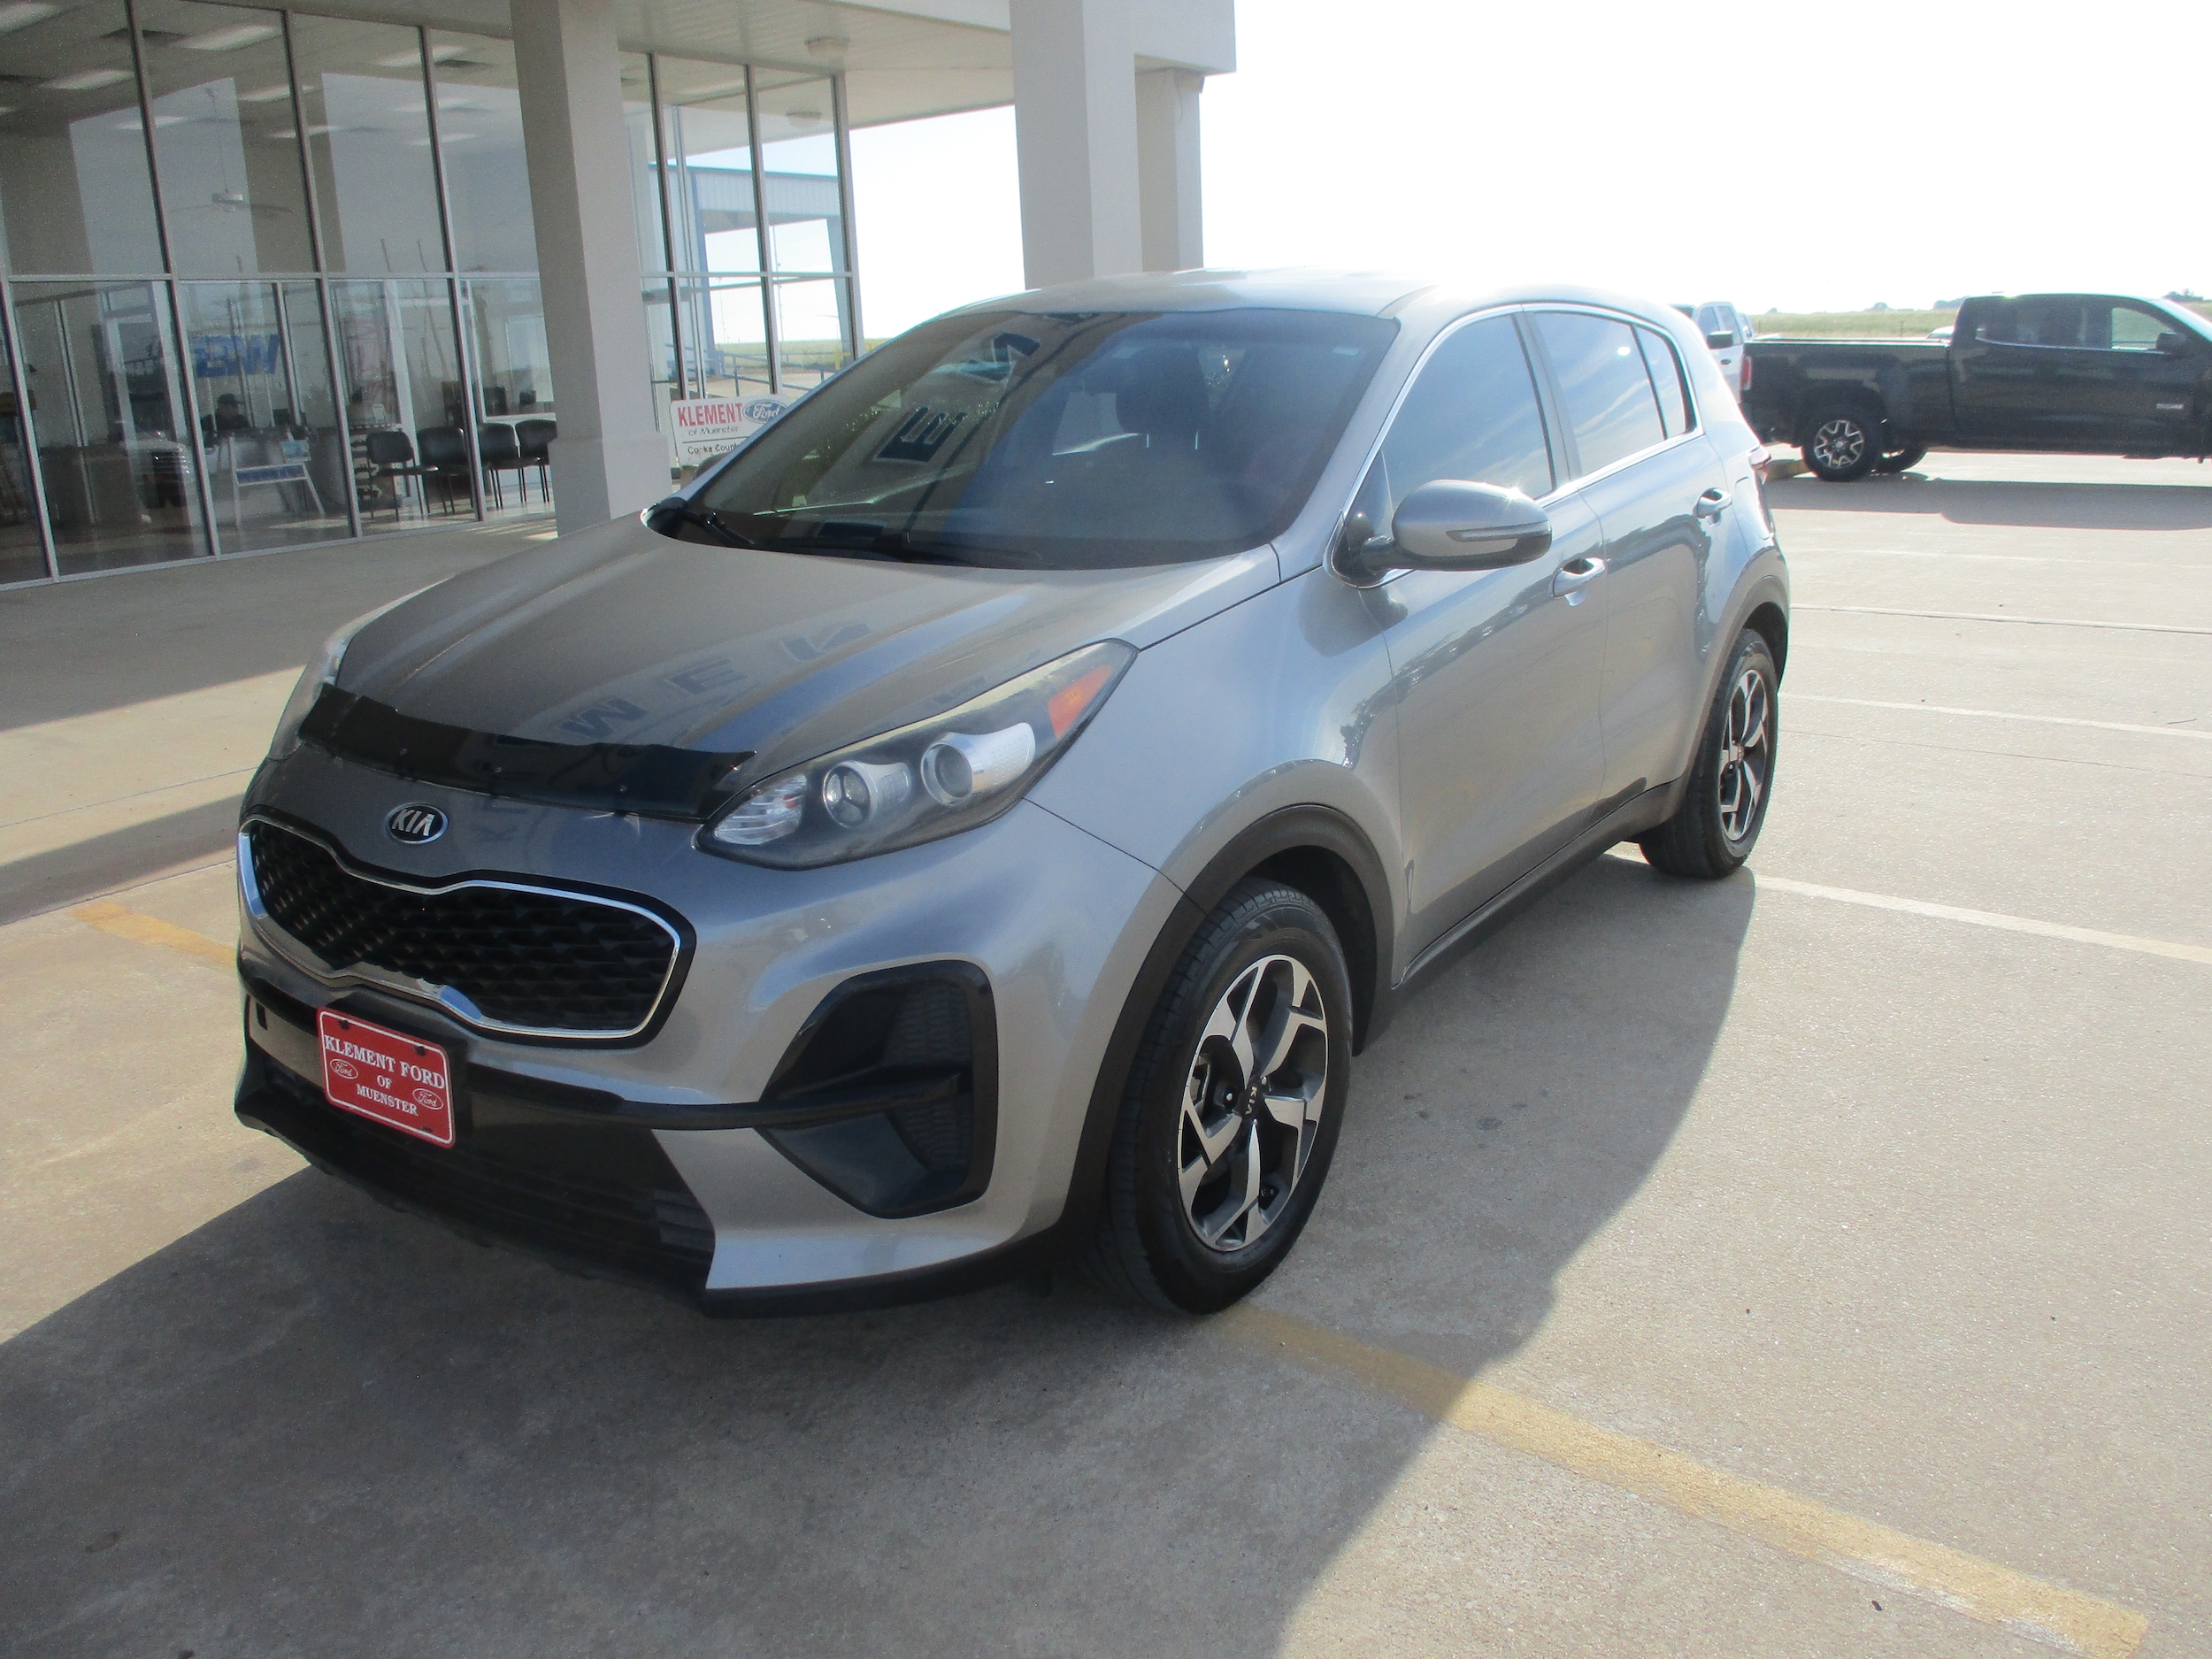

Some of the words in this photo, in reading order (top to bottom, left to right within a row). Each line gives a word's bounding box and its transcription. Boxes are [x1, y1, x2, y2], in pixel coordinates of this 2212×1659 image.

[678, 403, 742, 426] KLEMENT
[752, 403, 780, 419] Ford
[391, 809, 435, 836] KIA
[324, 1034, 396, 1073] KLEMENT
[400, 1060, 445, 1089] FORD
[334, 1061, 354, 1078] Ford
[376, 1074, 393, 1089] OF
[356, 1083, 419, 1117] MUENSTER
[418, 1091, 439, 1108] Ford
